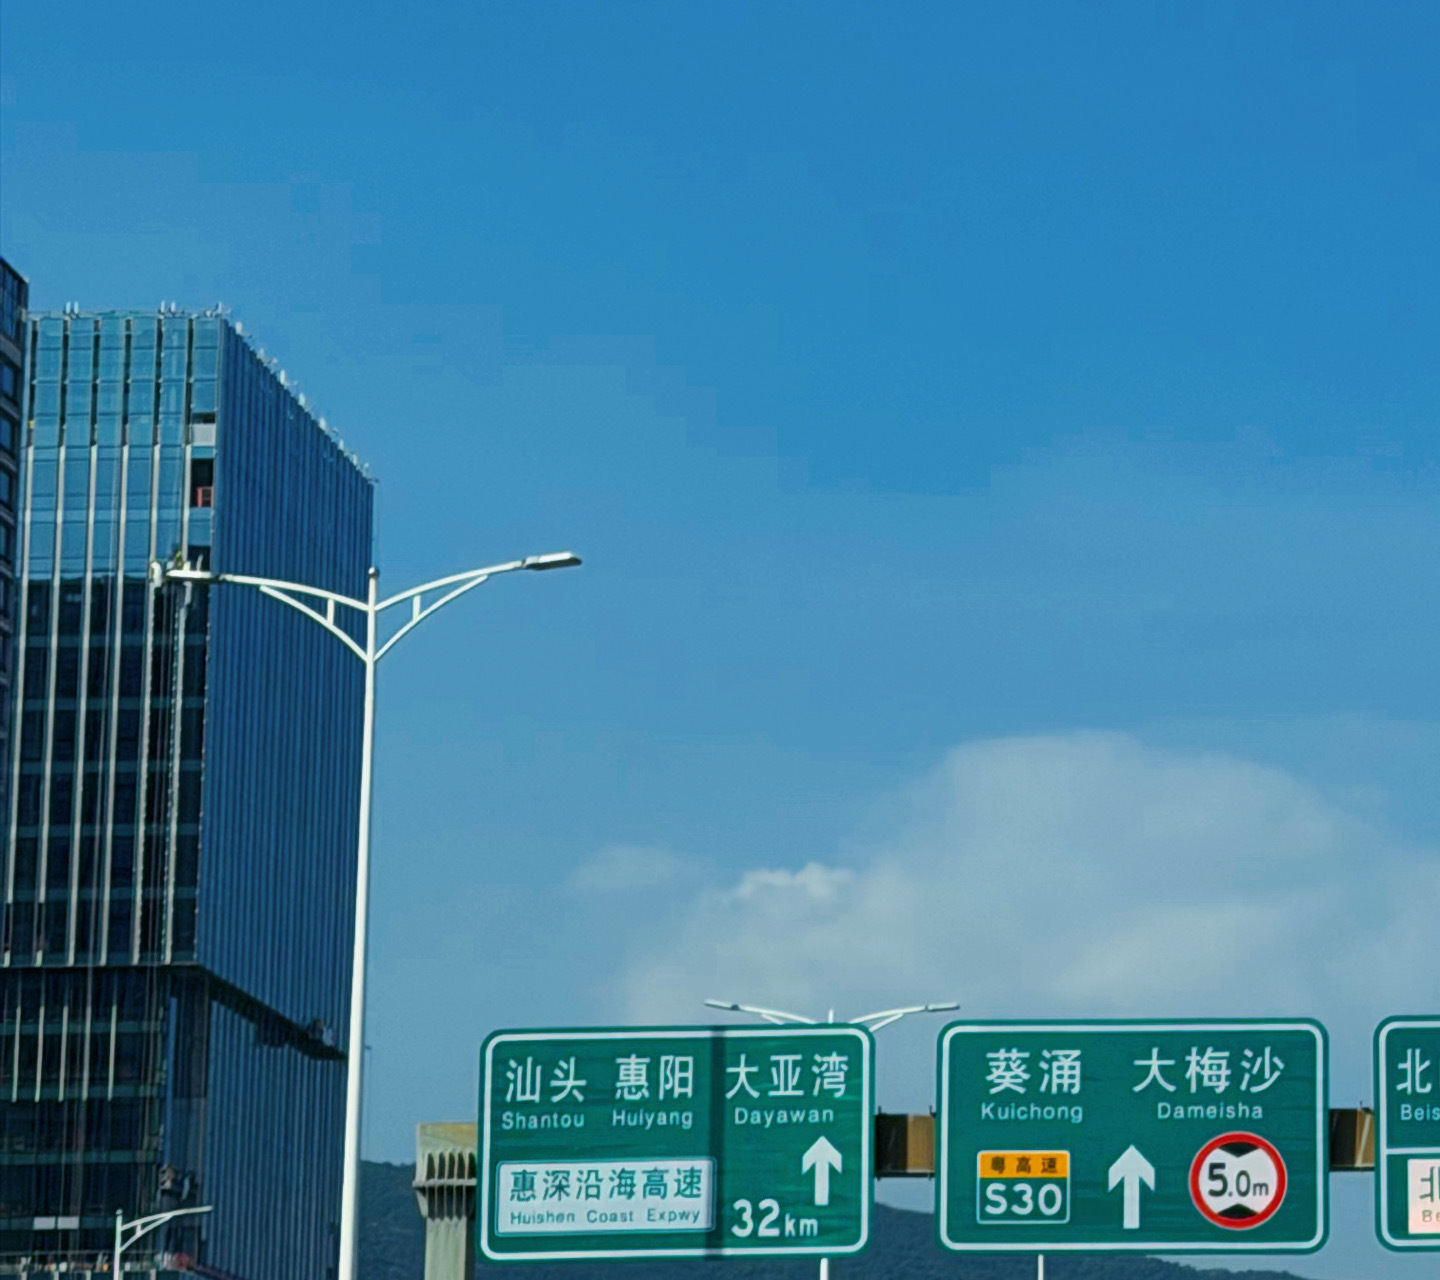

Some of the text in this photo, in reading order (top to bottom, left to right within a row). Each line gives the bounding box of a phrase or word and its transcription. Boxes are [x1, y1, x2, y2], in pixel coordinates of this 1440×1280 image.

[506, 1051, 849, 1103] 汕头 惠阳 大亚湾
[985, 1046, 1285, 1095] 葵涌 大梅沙
[502, 1107, 834, 1130] Shantou Huiyang Dayawan
[981, 1102, 1263, 1123] Kuichong Dameisha
[510, 1167, 702, 1202] 惠深沿海高速
[1208, 1162, 1269, 1197] 5.0m
[510, 1208, 700, 1225] Huishen Coast Expwy
[985, 1183, 1062, 1215] S30
[731, 1198, 819, 1238] 32km
